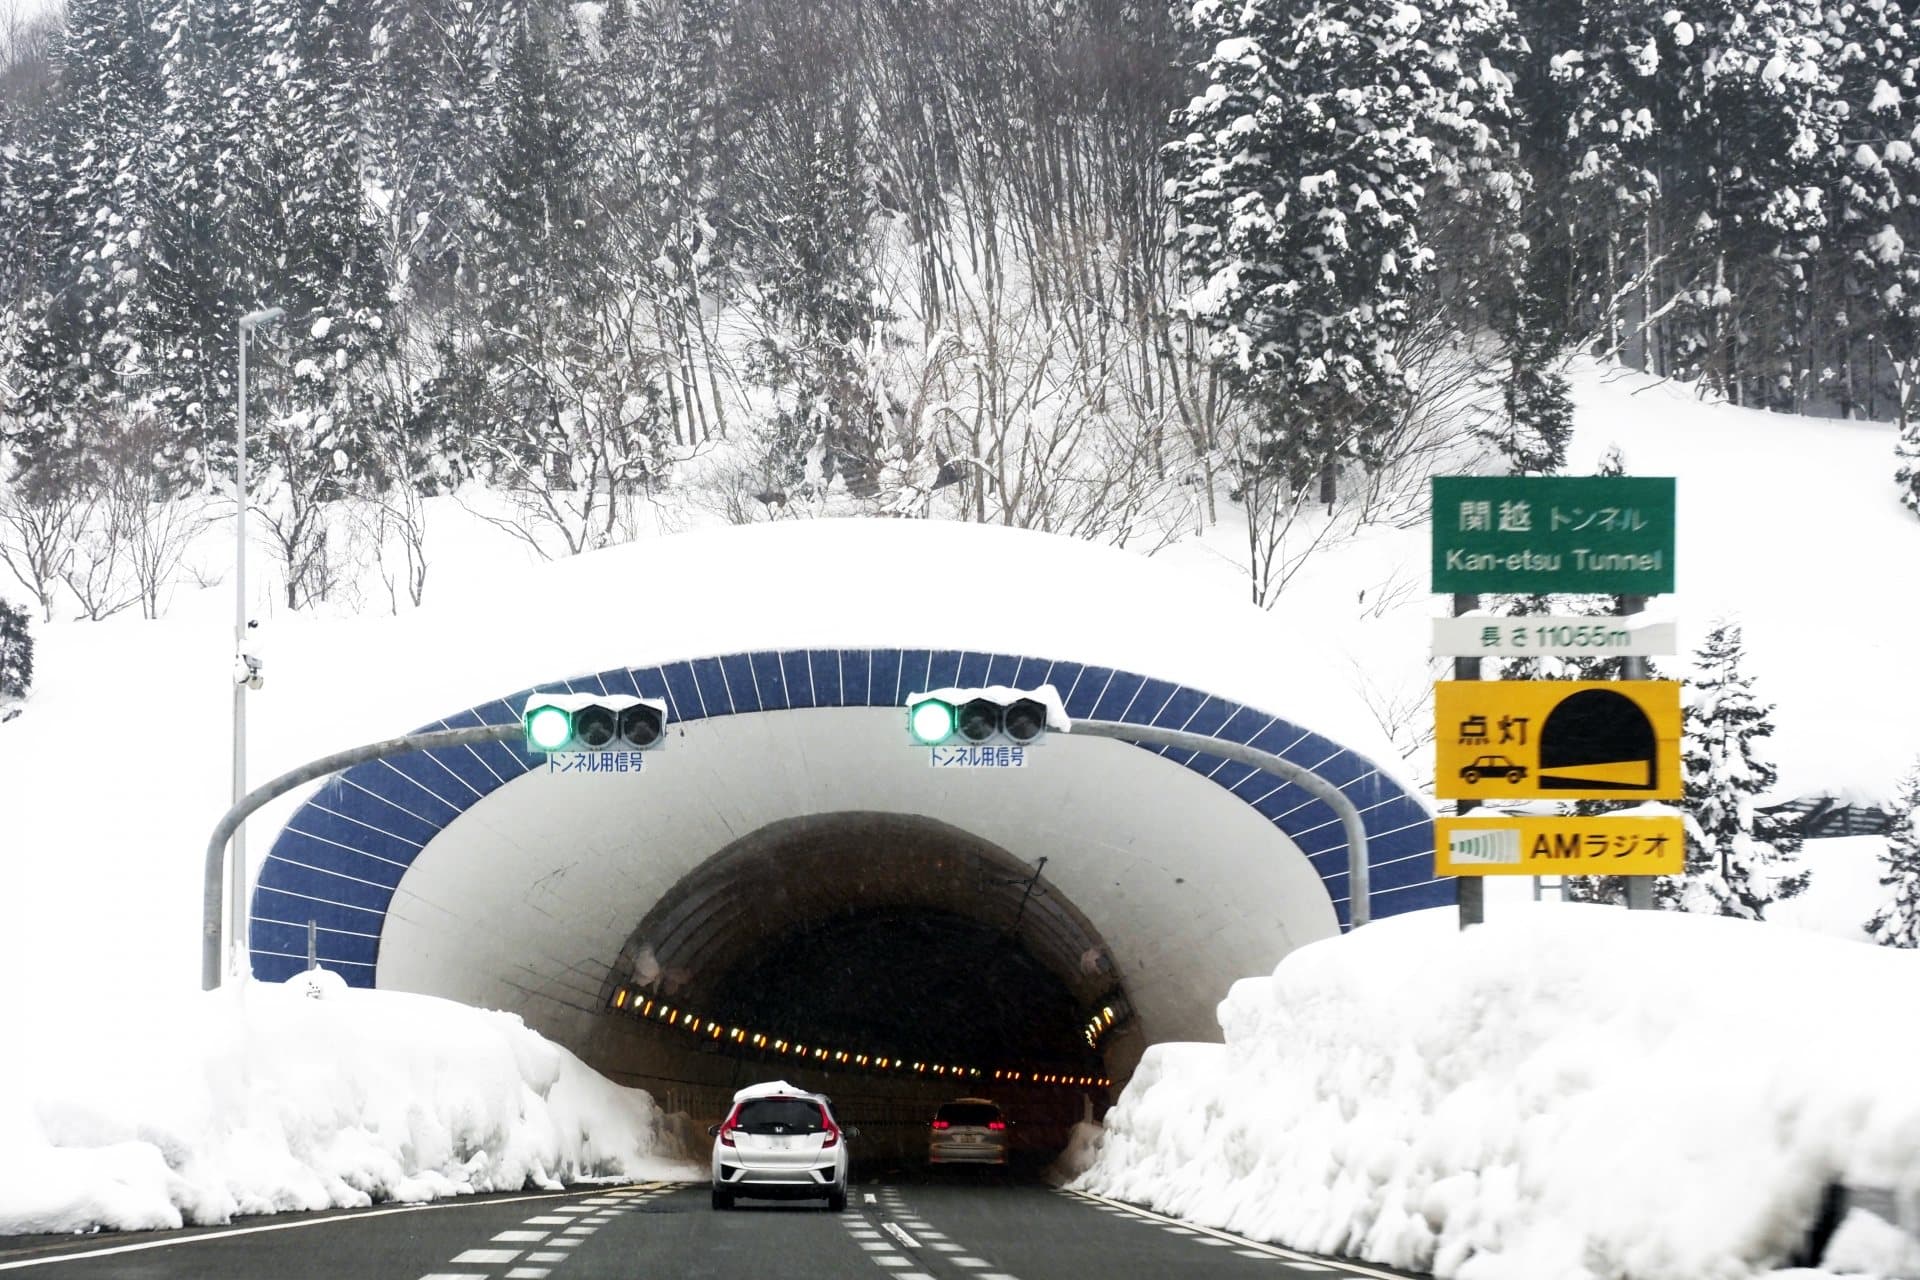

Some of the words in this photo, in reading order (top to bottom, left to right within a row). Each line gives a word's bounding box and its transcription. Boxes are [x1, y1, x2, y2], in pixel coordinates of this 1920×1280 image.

[1446, 549, 1561, 571] Kan-etsu
[1570, 549, 1662, 571] Tunnel
[1458, 714, 1531, 746] 点灯
[550, 752, 643, 773] トンネル用信号
[931, 746, 1024, 767] トンネル用信号
[1530, 833, 1669, 859] AMラジオ
